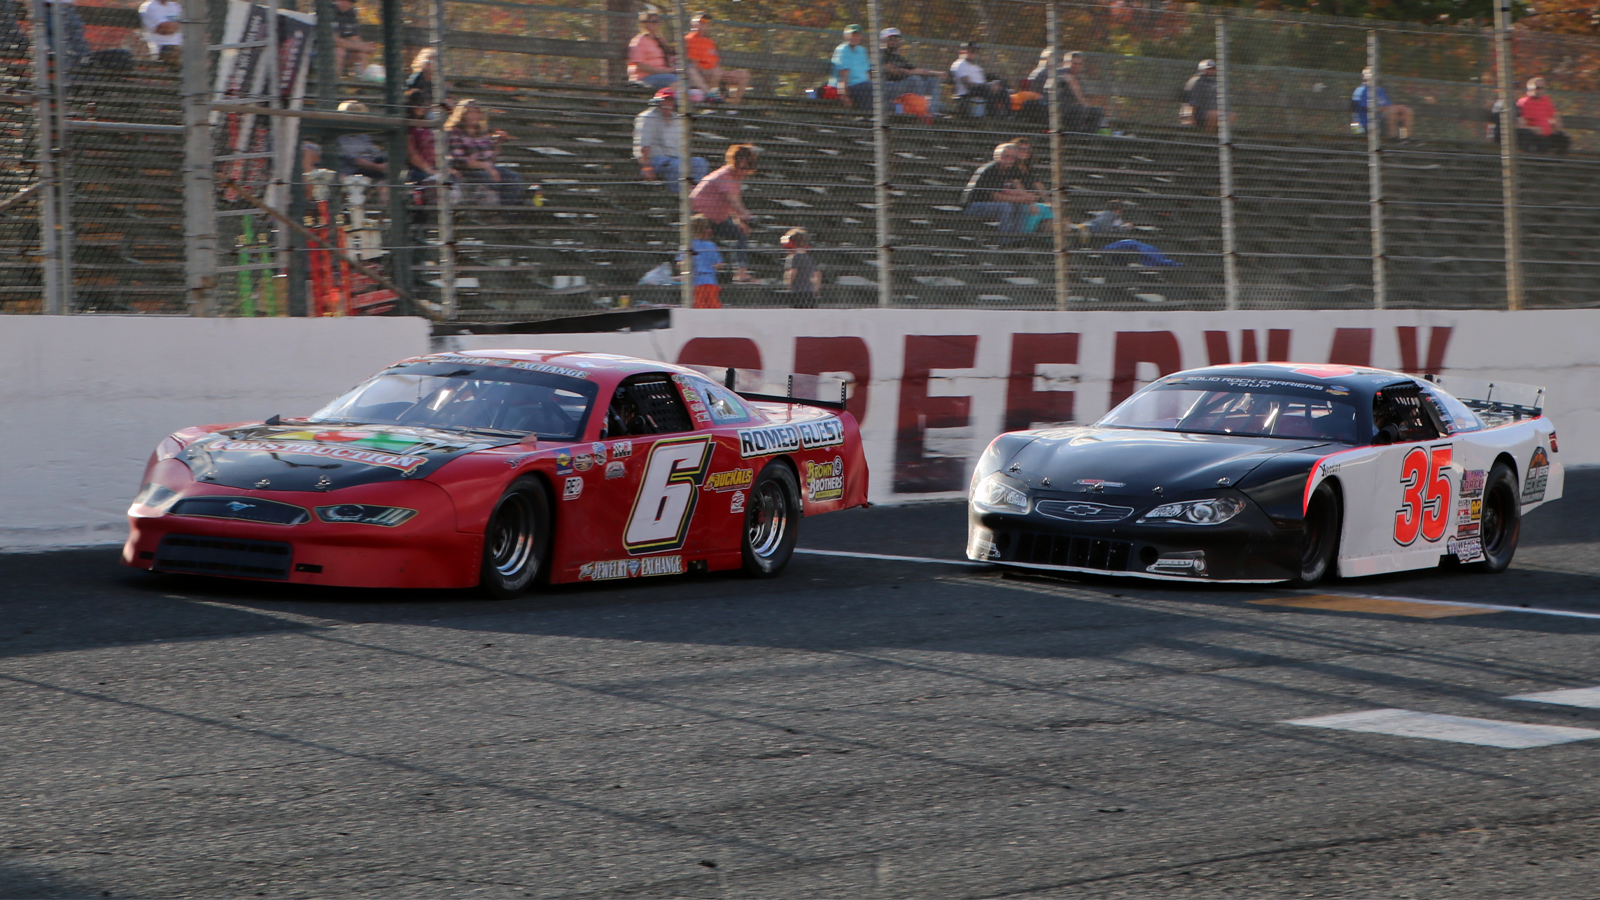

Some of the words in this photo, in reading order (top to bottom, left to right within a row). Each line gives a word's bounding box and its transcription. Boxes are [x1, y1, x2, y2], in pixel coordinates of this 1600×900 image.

[512, 361, 590, 380] EXCHANGE
[1258, 379, 1325, 391] CARRIERS
[675, 326, 1455, 495] PEED
[739, 425, 799, 454] ROMEO
[799, 419, 844, 445] GUEST
[207, 438, 421, 468] CONSTRUCTION
[807, 462, 833, 483] BROWN
[623, 434, 715, 556] 6
[808, 477, 842, 498] BROTHERS
[1393, 443, 1453, 547] 35
[1524, 478, 1548, 494] EDGE
[592, 561, 629, 580] JEWELRY
[641, 556, 683, 577] EXCHANGE
